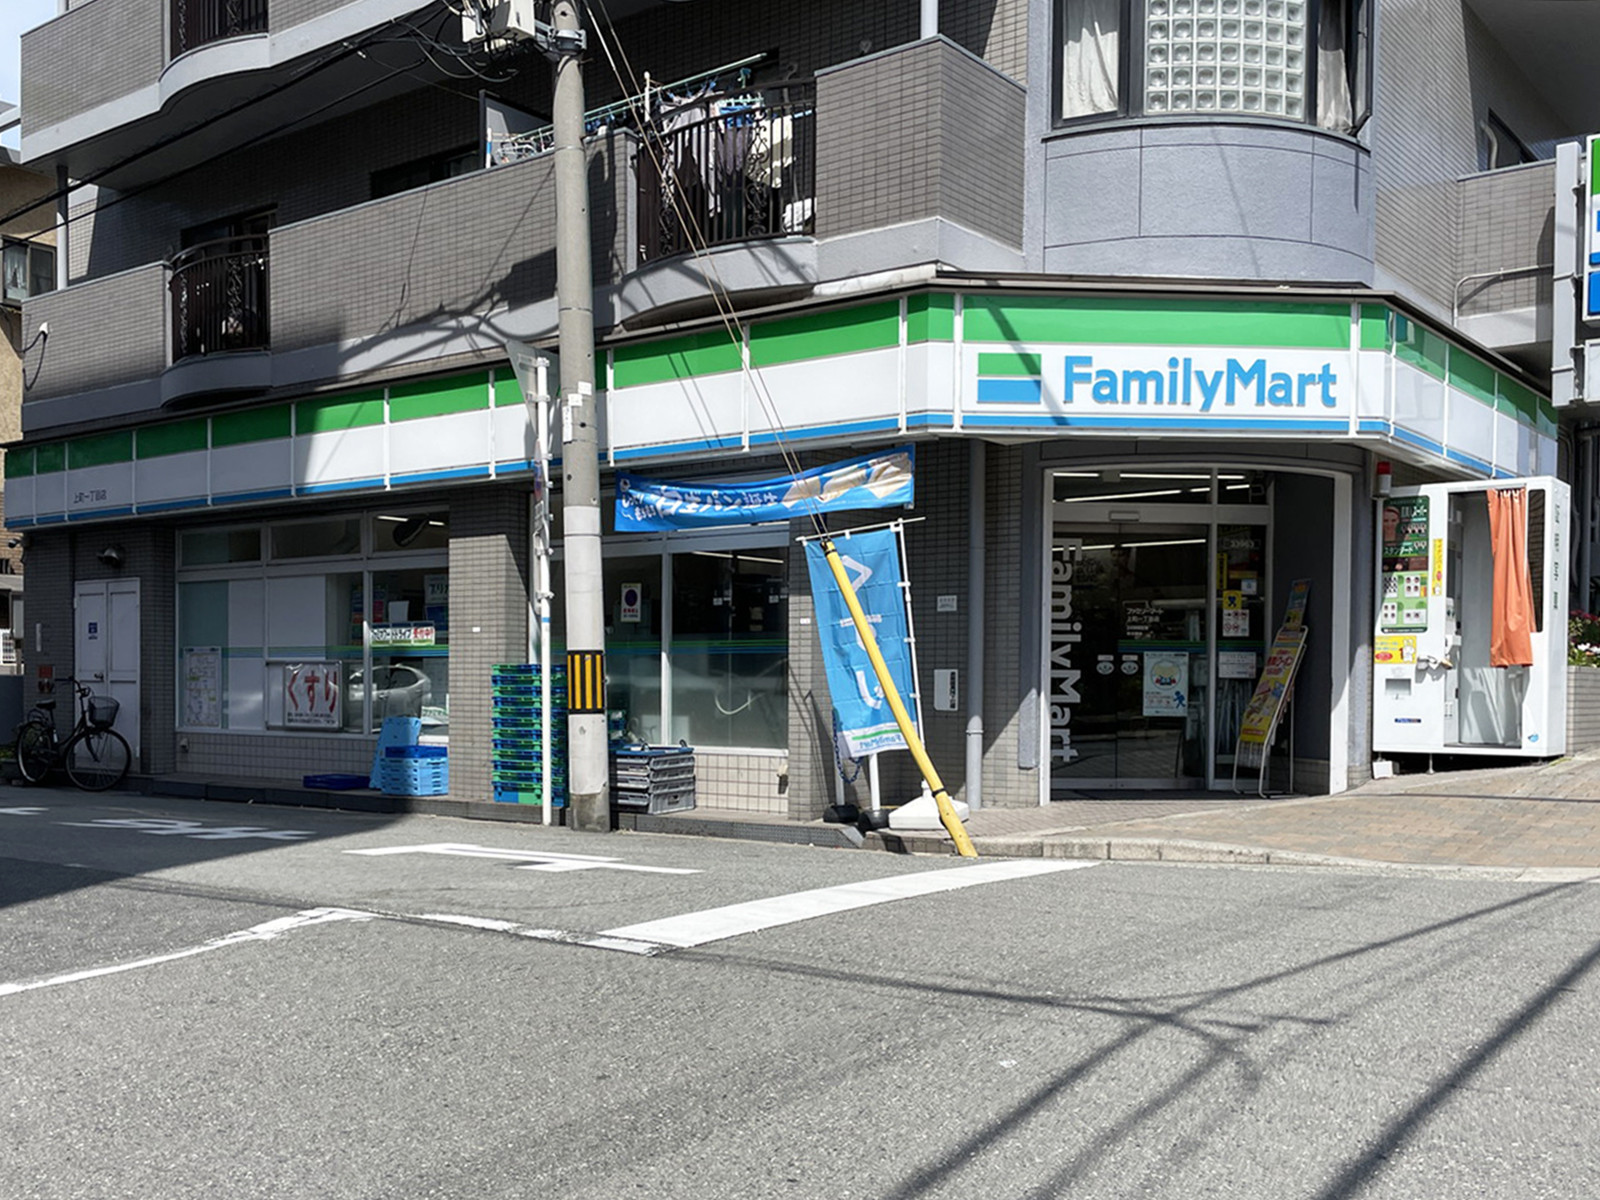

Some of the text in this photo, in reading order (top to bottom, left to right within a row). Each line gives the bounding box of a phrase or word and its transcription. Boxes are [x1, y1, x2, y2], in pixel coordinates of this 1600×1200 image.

[1064, 356, 1336, 411] FamilyMart
[1049, 538, 1081, 763] FamilyMart
[287, 670, 338, 713] くすり
